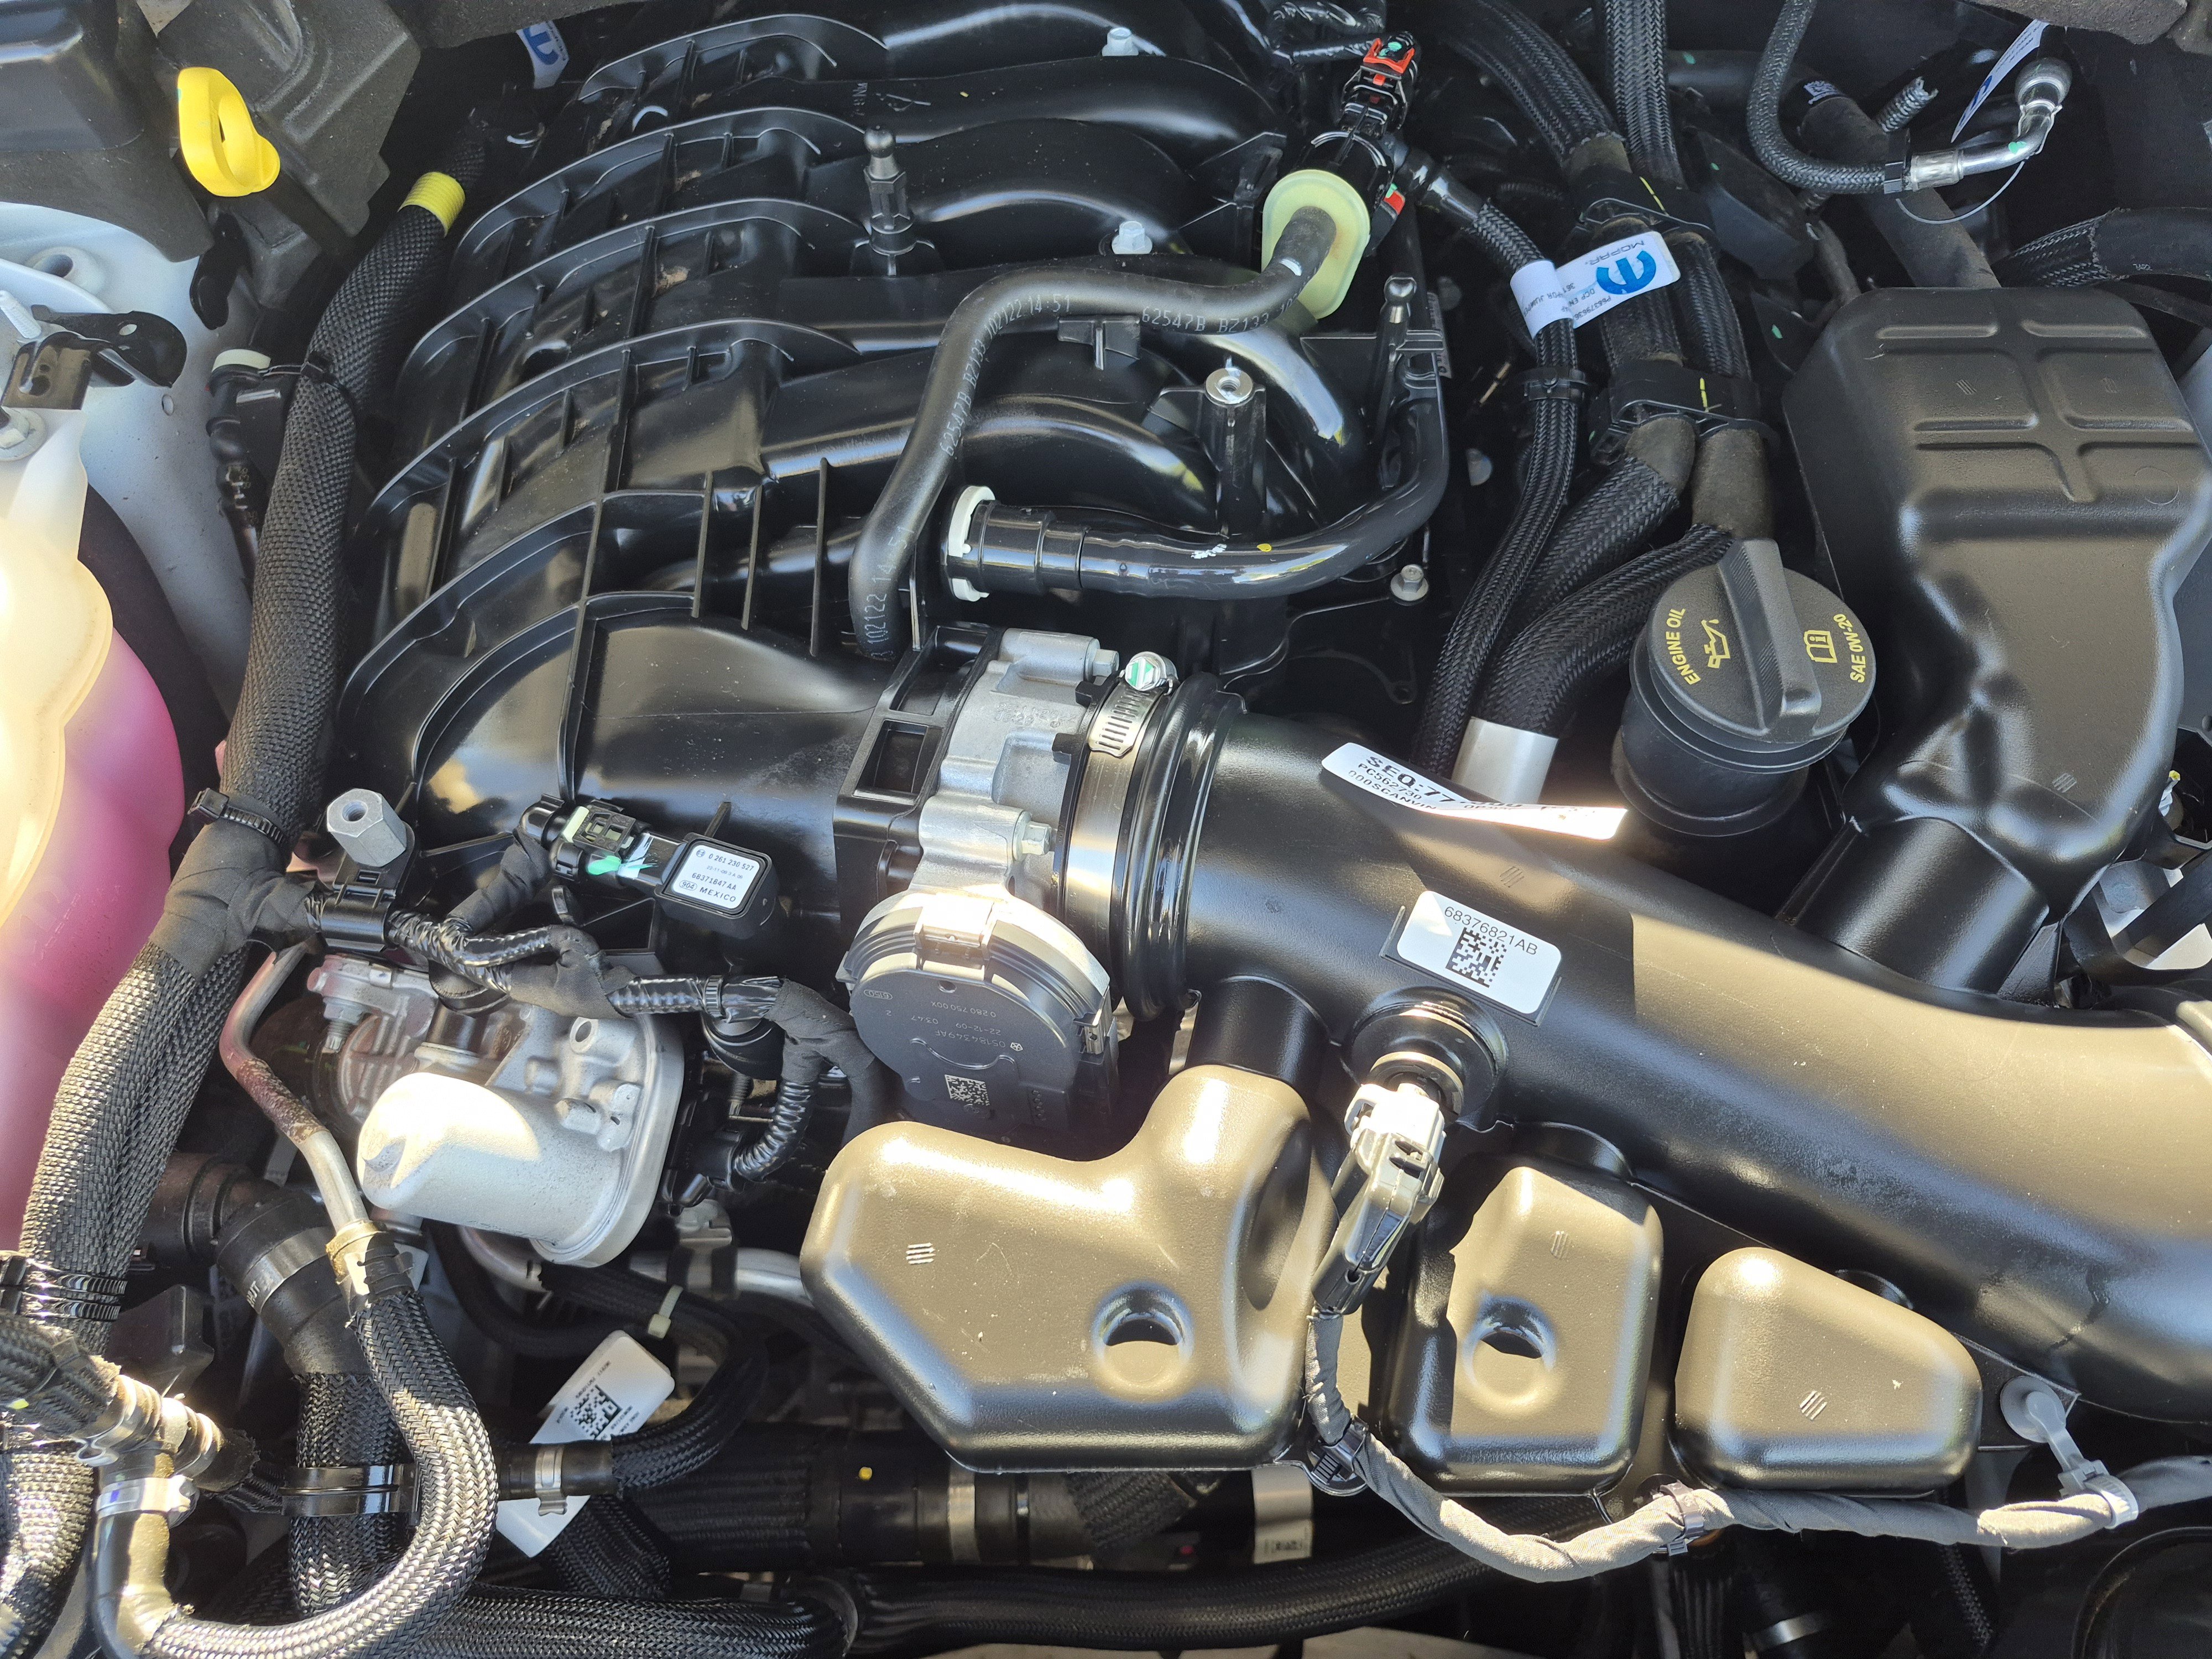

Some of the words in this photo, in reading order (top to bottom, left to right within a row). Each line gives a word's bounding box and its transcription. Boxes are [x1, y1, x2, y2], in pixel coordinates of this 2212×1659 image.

[1588, 239, 1646, 266] MOPAR
[940, 392, 971, 456] 62547B
[1141, 306, 1207, 332] 62547B
[1218, 312, 1270, 333] BZ133
[1666, 608, 1686, 628] OIL
[1833, 613, 1864, 653] 0W-20
[1665, 631, 1702, 685] ENGINE
[1850, 654, 1866, 683] SAE
[1348, 770, 1437, 809] 000SCANVIN
[1358, 763, 1422, 800] PC562730
[741, 863, 755, 872] 527
[682, 881, 695, 889] 904
[699, 886, 737, 902] MEXICO
[1444, 906, 1538, 956] 68376821AB
[950, 1004, 968, 1013] 750
[970, 1007, 989, 1016] 280
[935, 1029, 1006, 1048] 05184349AF
[956, 1022, 1001, 1036] 22-12-09
